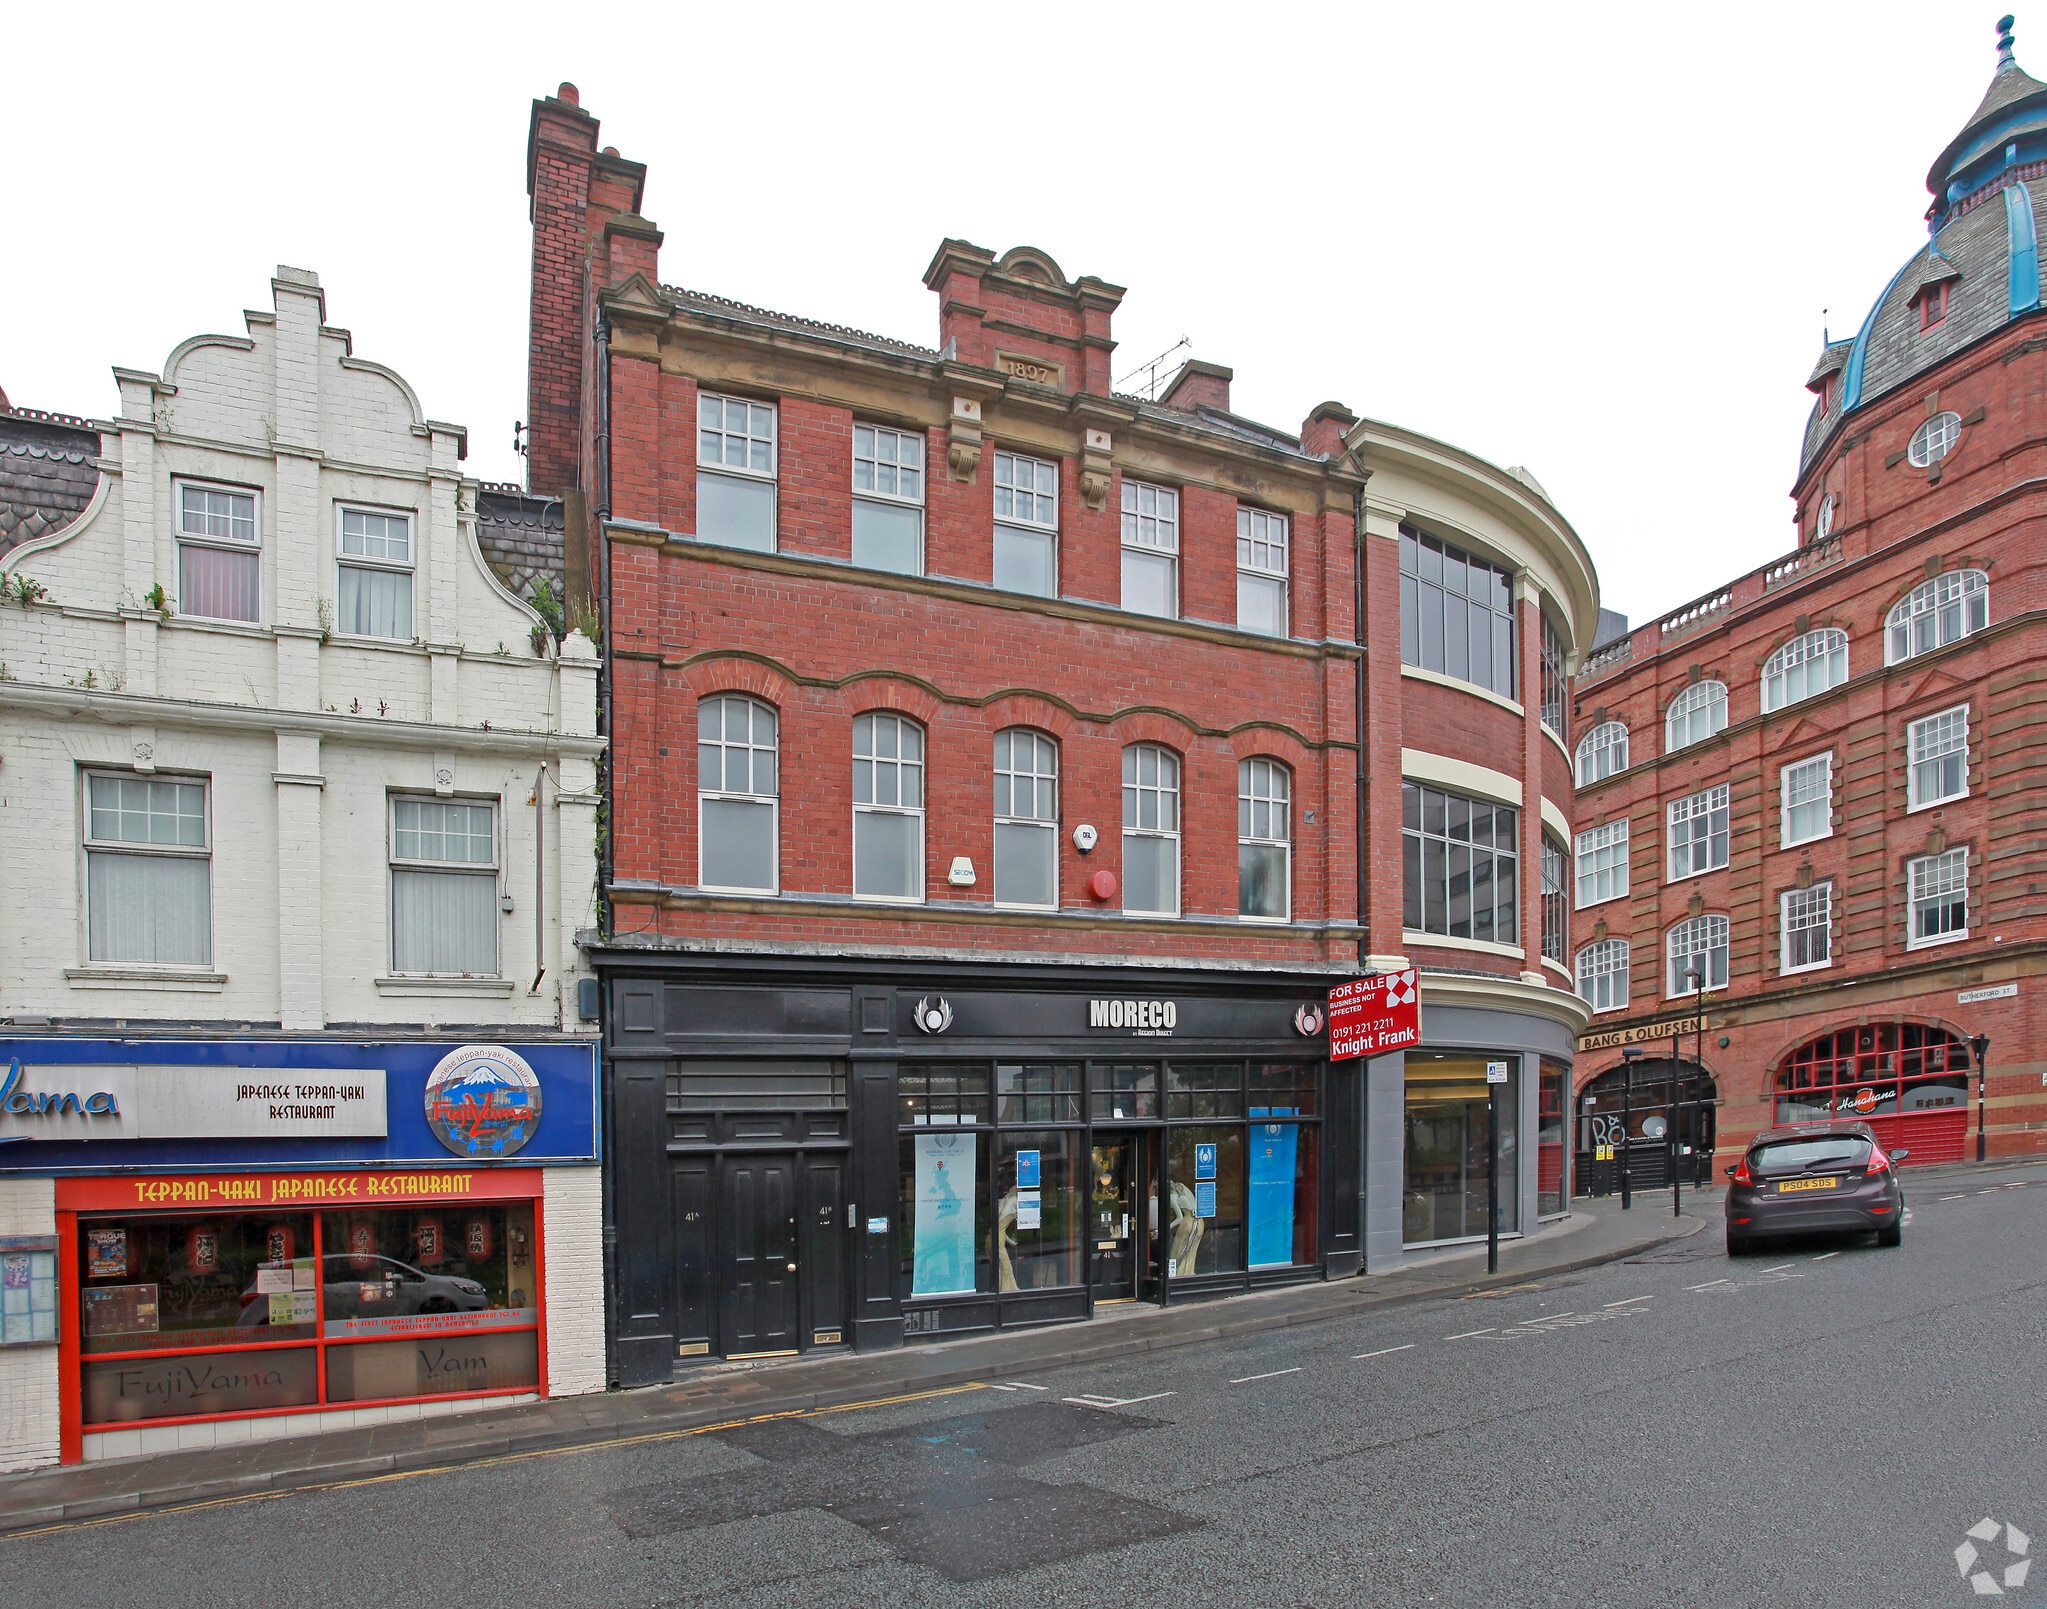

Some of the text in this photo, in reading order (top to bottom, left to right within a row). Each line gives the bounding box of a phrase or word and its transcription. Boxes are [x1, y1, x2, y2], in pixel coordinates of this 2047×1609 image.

[1009, 362, 1048, 382] 1897
[954, 869, 974, 877] SECOM
[1329, 977, 1385, 1000] FOR SALE
[1960, 989, 2000, 1001] RUTHERFORD
[1329, 993, 1376, 1009] BUSINESS NOT
[1329, 1004, 1362, 1018] AFFECTED
[1090, 999, 1177, 1028] MORECO
[1332, 1017, 1394, 1039] 0191 221 2211
[1584, 1033, 1620, 1049] BANG
[1624, 1030, 1633, 1042] &
[1636, 1018, 1699, 1040] OLUFSEN
[1332, 1026, 1415, 1056] Knight Frank
[457, 1049, 505, 1063] teppan-yaki
[0, 1057, 119, 1142] ama
[236, 1084, 365, 1102] JAPENESE TEPPAN-YAKI
[1836, 1089, 1897, 1111] Hanahana
[270, 1105, 336, 1119] RESTAURANT
[432, 1091, 533, 1137] FujiYama
[134, 1174, 473, 1203] TEPPAN-YAKI JAPANESE RESTAURANT
[115, 1365, 283, 1403] FujiYama
